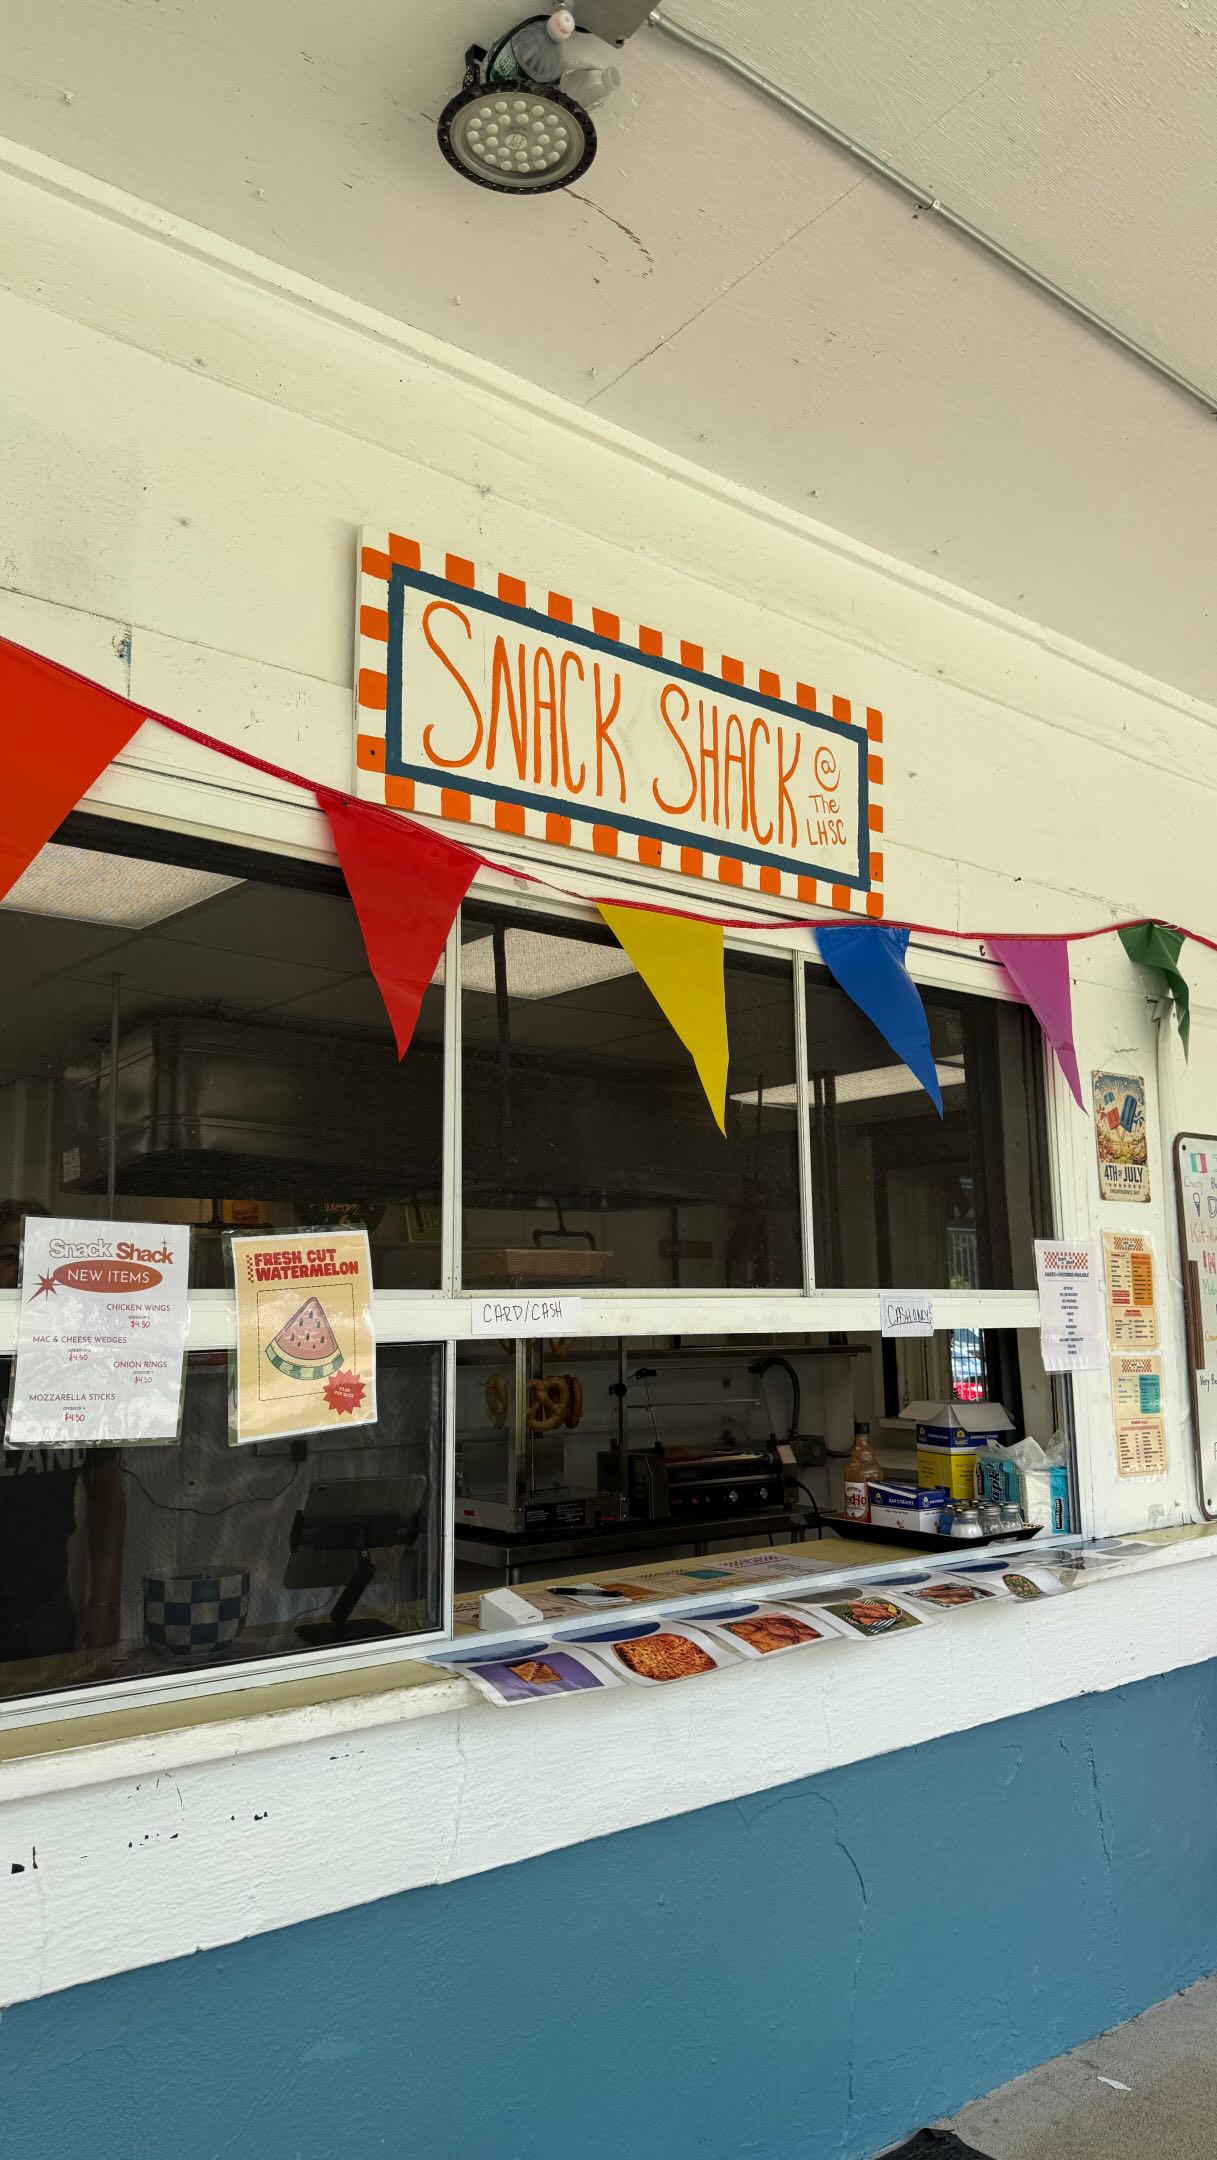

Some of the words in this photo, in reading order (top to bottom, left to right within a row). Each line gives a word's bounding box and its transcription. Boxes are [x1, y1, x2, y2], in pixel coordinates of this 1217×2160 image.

[422, 600, 627, 804] SNACK
[652, 682, 802, 849] SHACK
[813, 745, 841, 792] @
[808, 794, 840, 815] The
[806, 817, 847, 847] LHSC
[1104, 1164, 1118, 1181] 4TH
[1123, 1164, 1143, 1183] JULY
[49, 1238, 113, 1258] Snack
[116, 1241, 174, 1265] Shack
[254, 1251, 302, 1267] FRESH
[307, 1249, 336, 1263] CUT
[67, 1269, 103, 1282] NEW
[107, 1270, 150, 1284] ITEMS
[255, 1260, 359, 1282] WATERMELON
[106, 1303, 142, 1312] CHICKEN
[144, 1304, 171, 1312] WINGS
[483, 1300, 562, 1322] CARD/CASH
[887, 1304, 911, 1326] CASH
[94, 1336, 127, 1344] WEDGES
[29, 1393, 86, 1401] MOZZARELLA
[89, 1393, 116, 1401] STICKS
